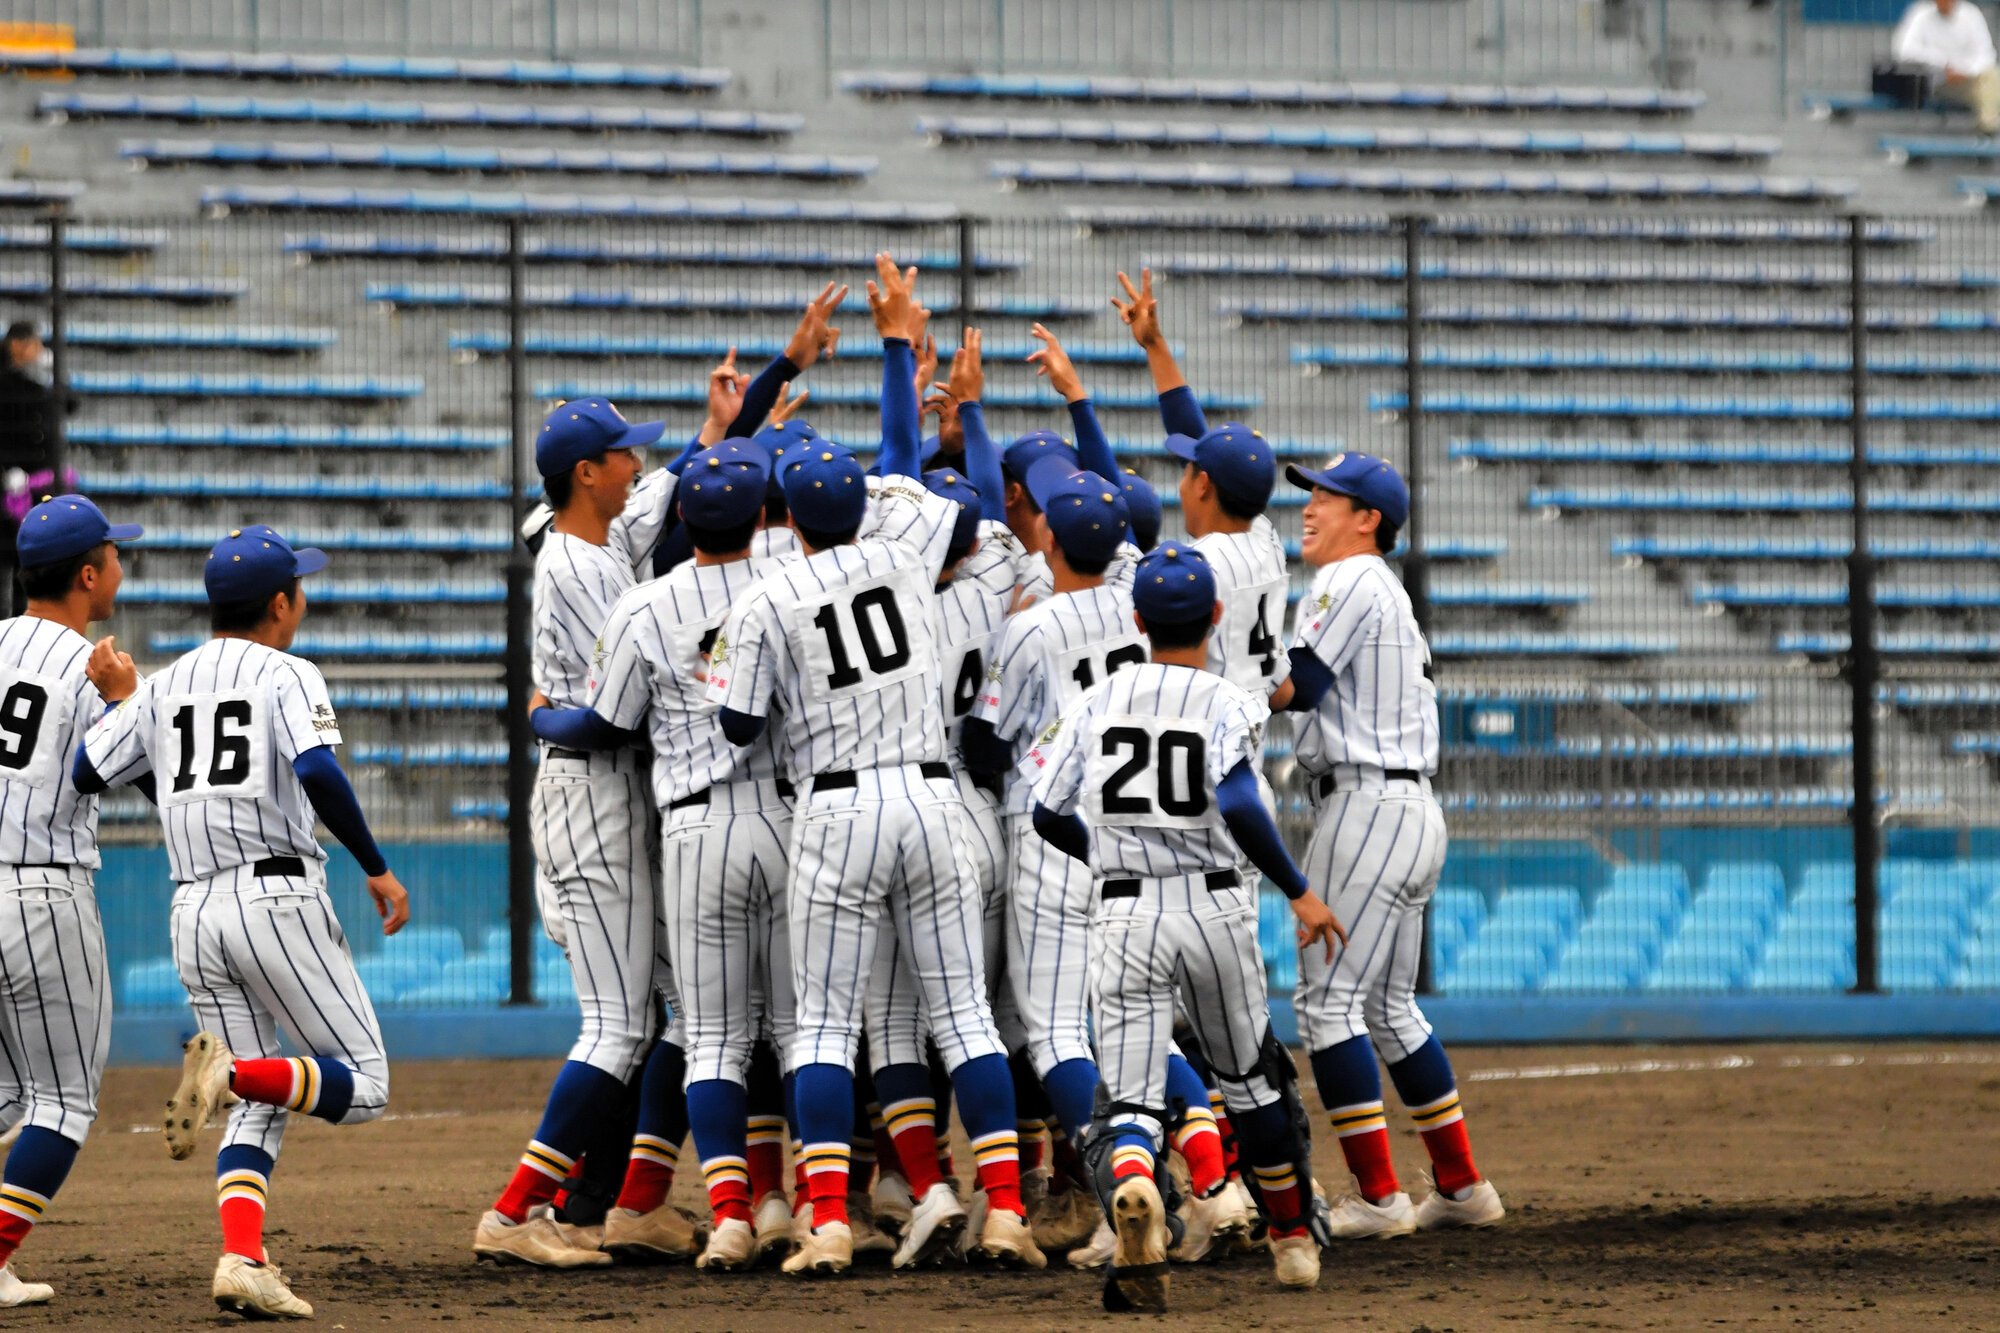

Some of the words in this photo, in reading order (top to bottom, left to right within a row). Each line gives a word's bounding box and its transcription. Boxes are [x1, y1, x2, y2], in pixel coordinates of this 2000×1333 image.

[813, 586, 911, 690] 10
[1248, 593, 1276, 677] 4
[0, 681, 48, 770] 9
[172, 699, 252, 794] 16
[1101, 726, 1210, 817] 20
